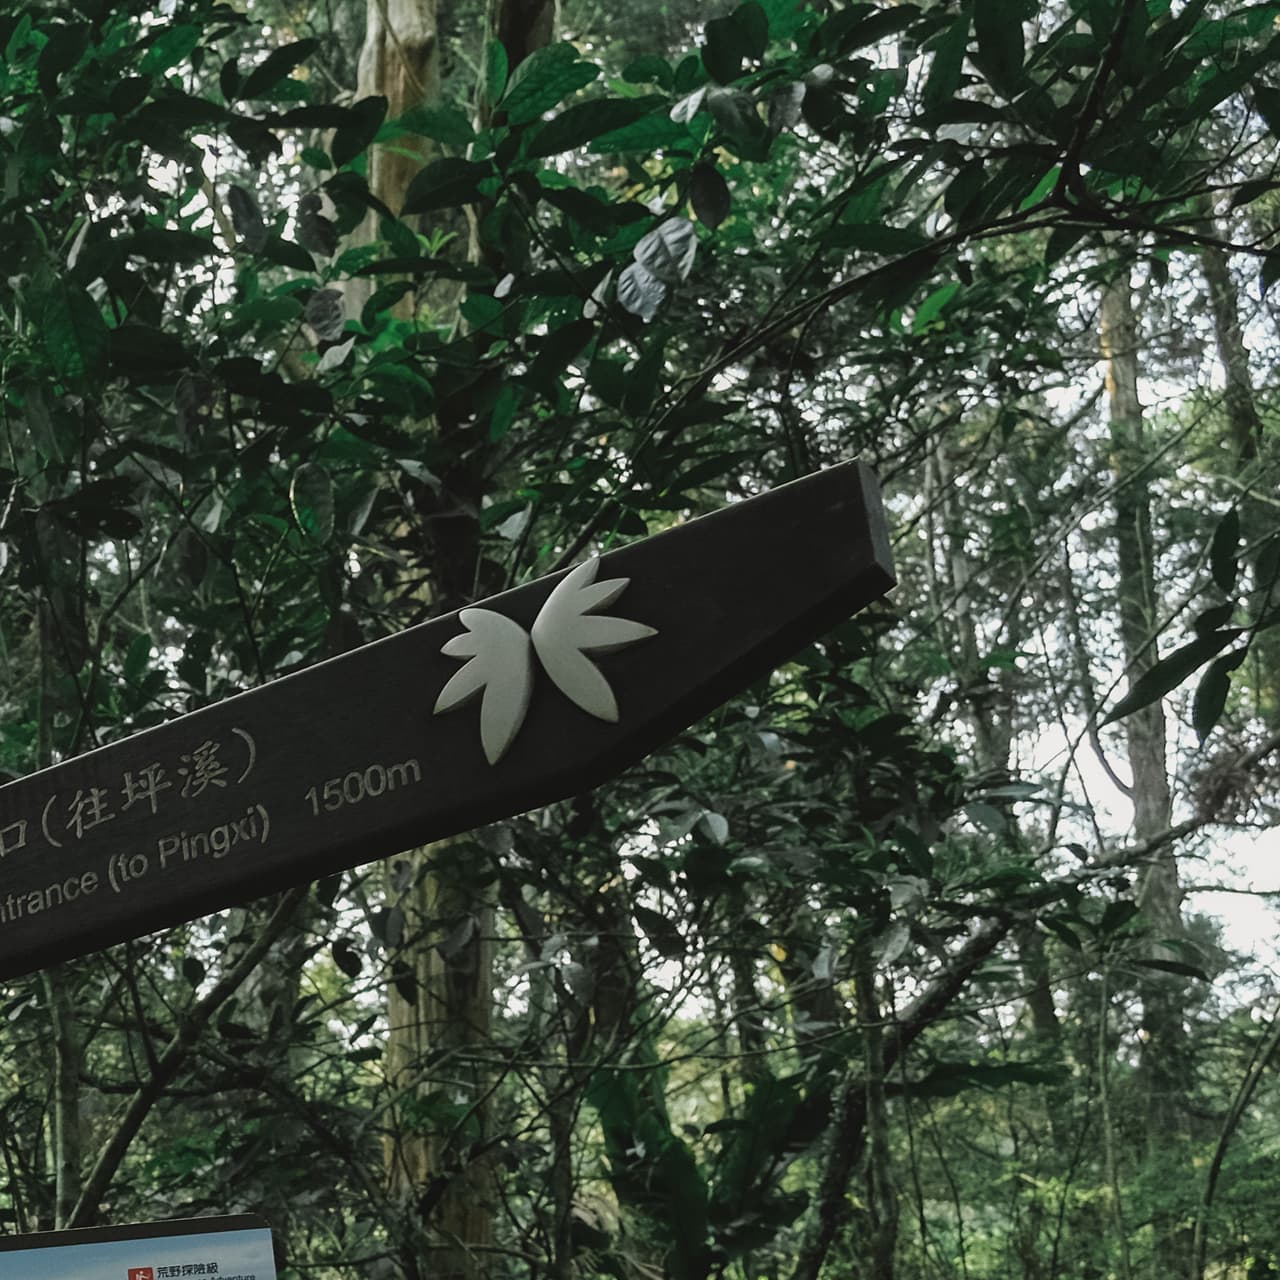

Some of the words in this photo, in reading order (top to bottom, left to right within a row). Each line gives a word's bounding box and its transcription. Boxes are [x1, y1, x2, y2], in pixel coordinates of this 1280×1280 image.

[305, 758, 422, 818] 1500m
[108, 851, 149, 893] (to
[158, 804, 270, 868] Pingxi)
[156, 1262, 219, 1280] 荒野探險級
